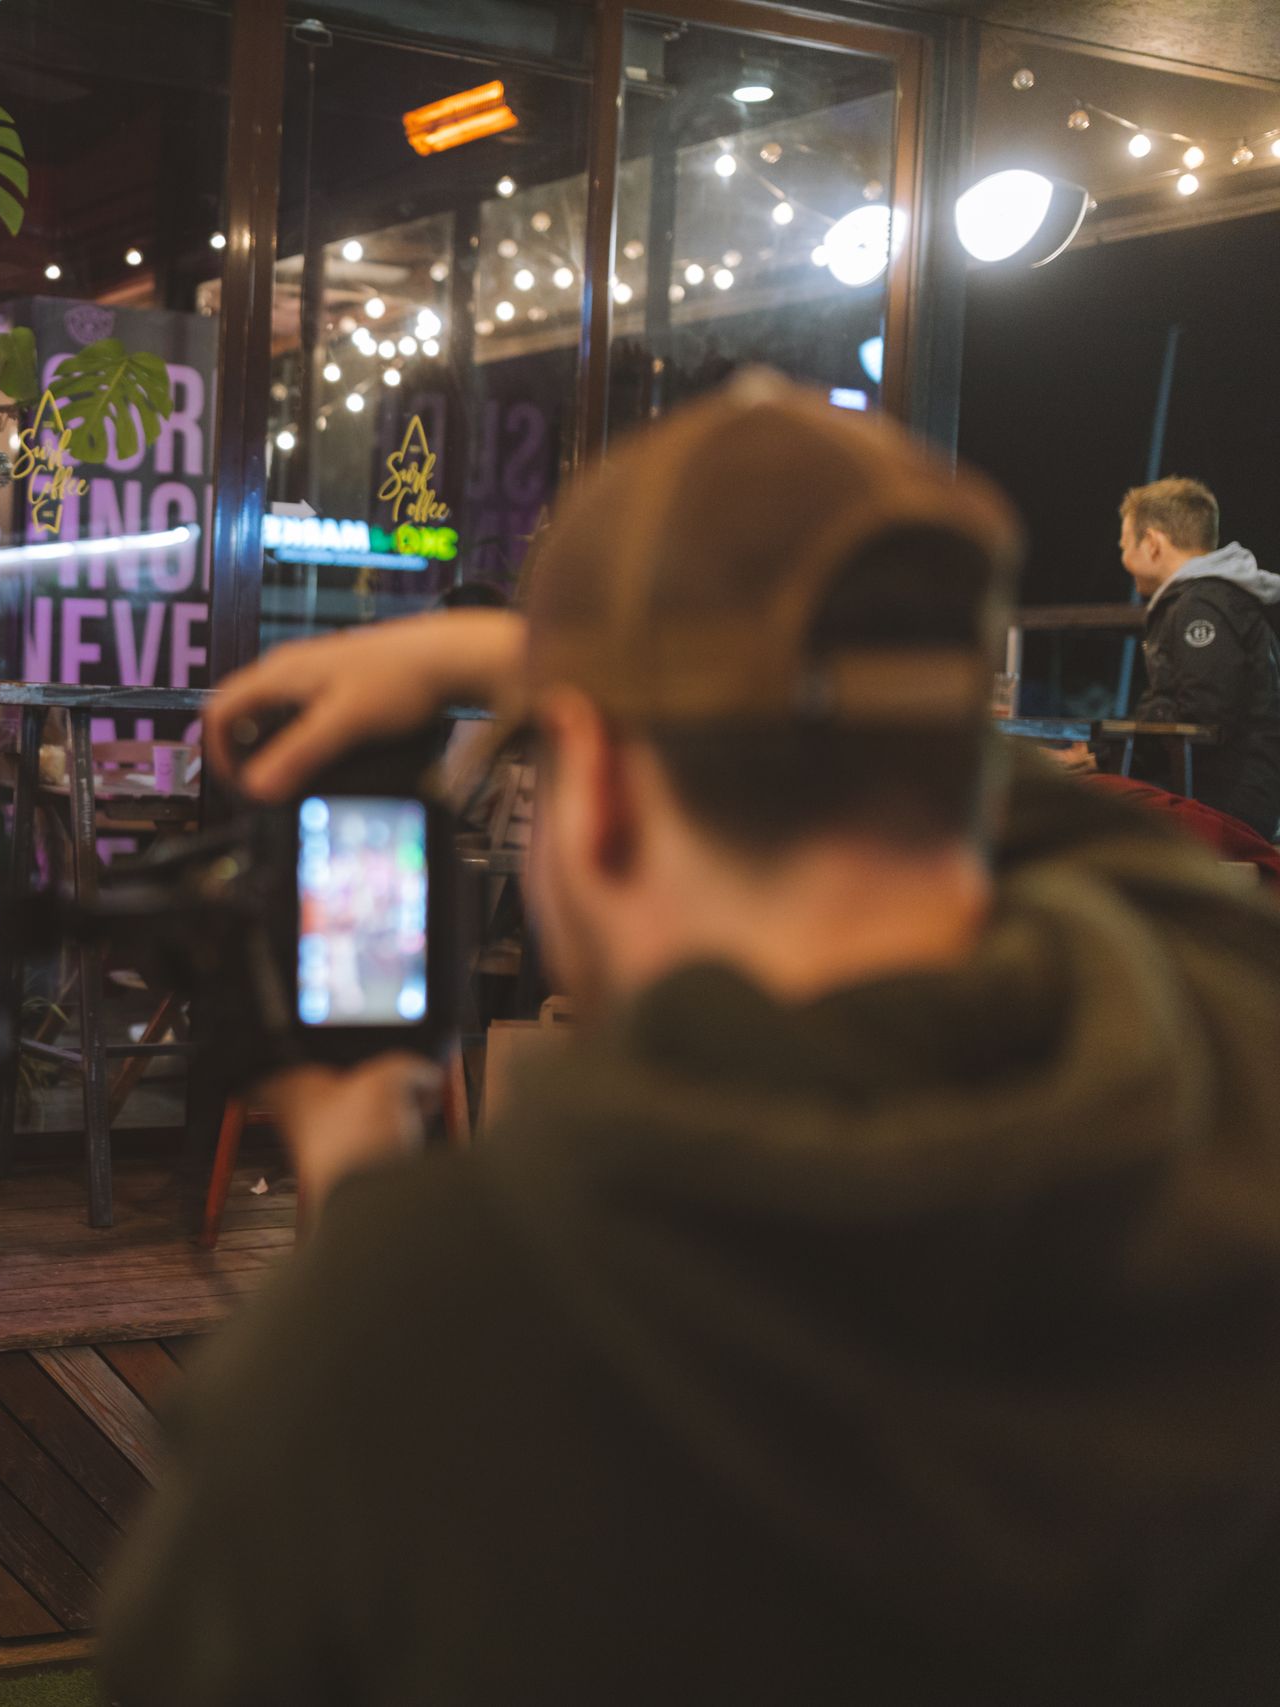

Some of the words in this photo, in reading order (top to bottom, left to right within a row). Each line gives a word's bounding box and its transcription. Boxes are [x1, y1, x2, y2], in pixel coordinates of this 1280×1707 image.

[11, 428, 72, 479] Surf
[28, 465, 89, 504] Coffee
[378, 452, 436, 500] Surf
[392, 487, 449, 522] Coffee
